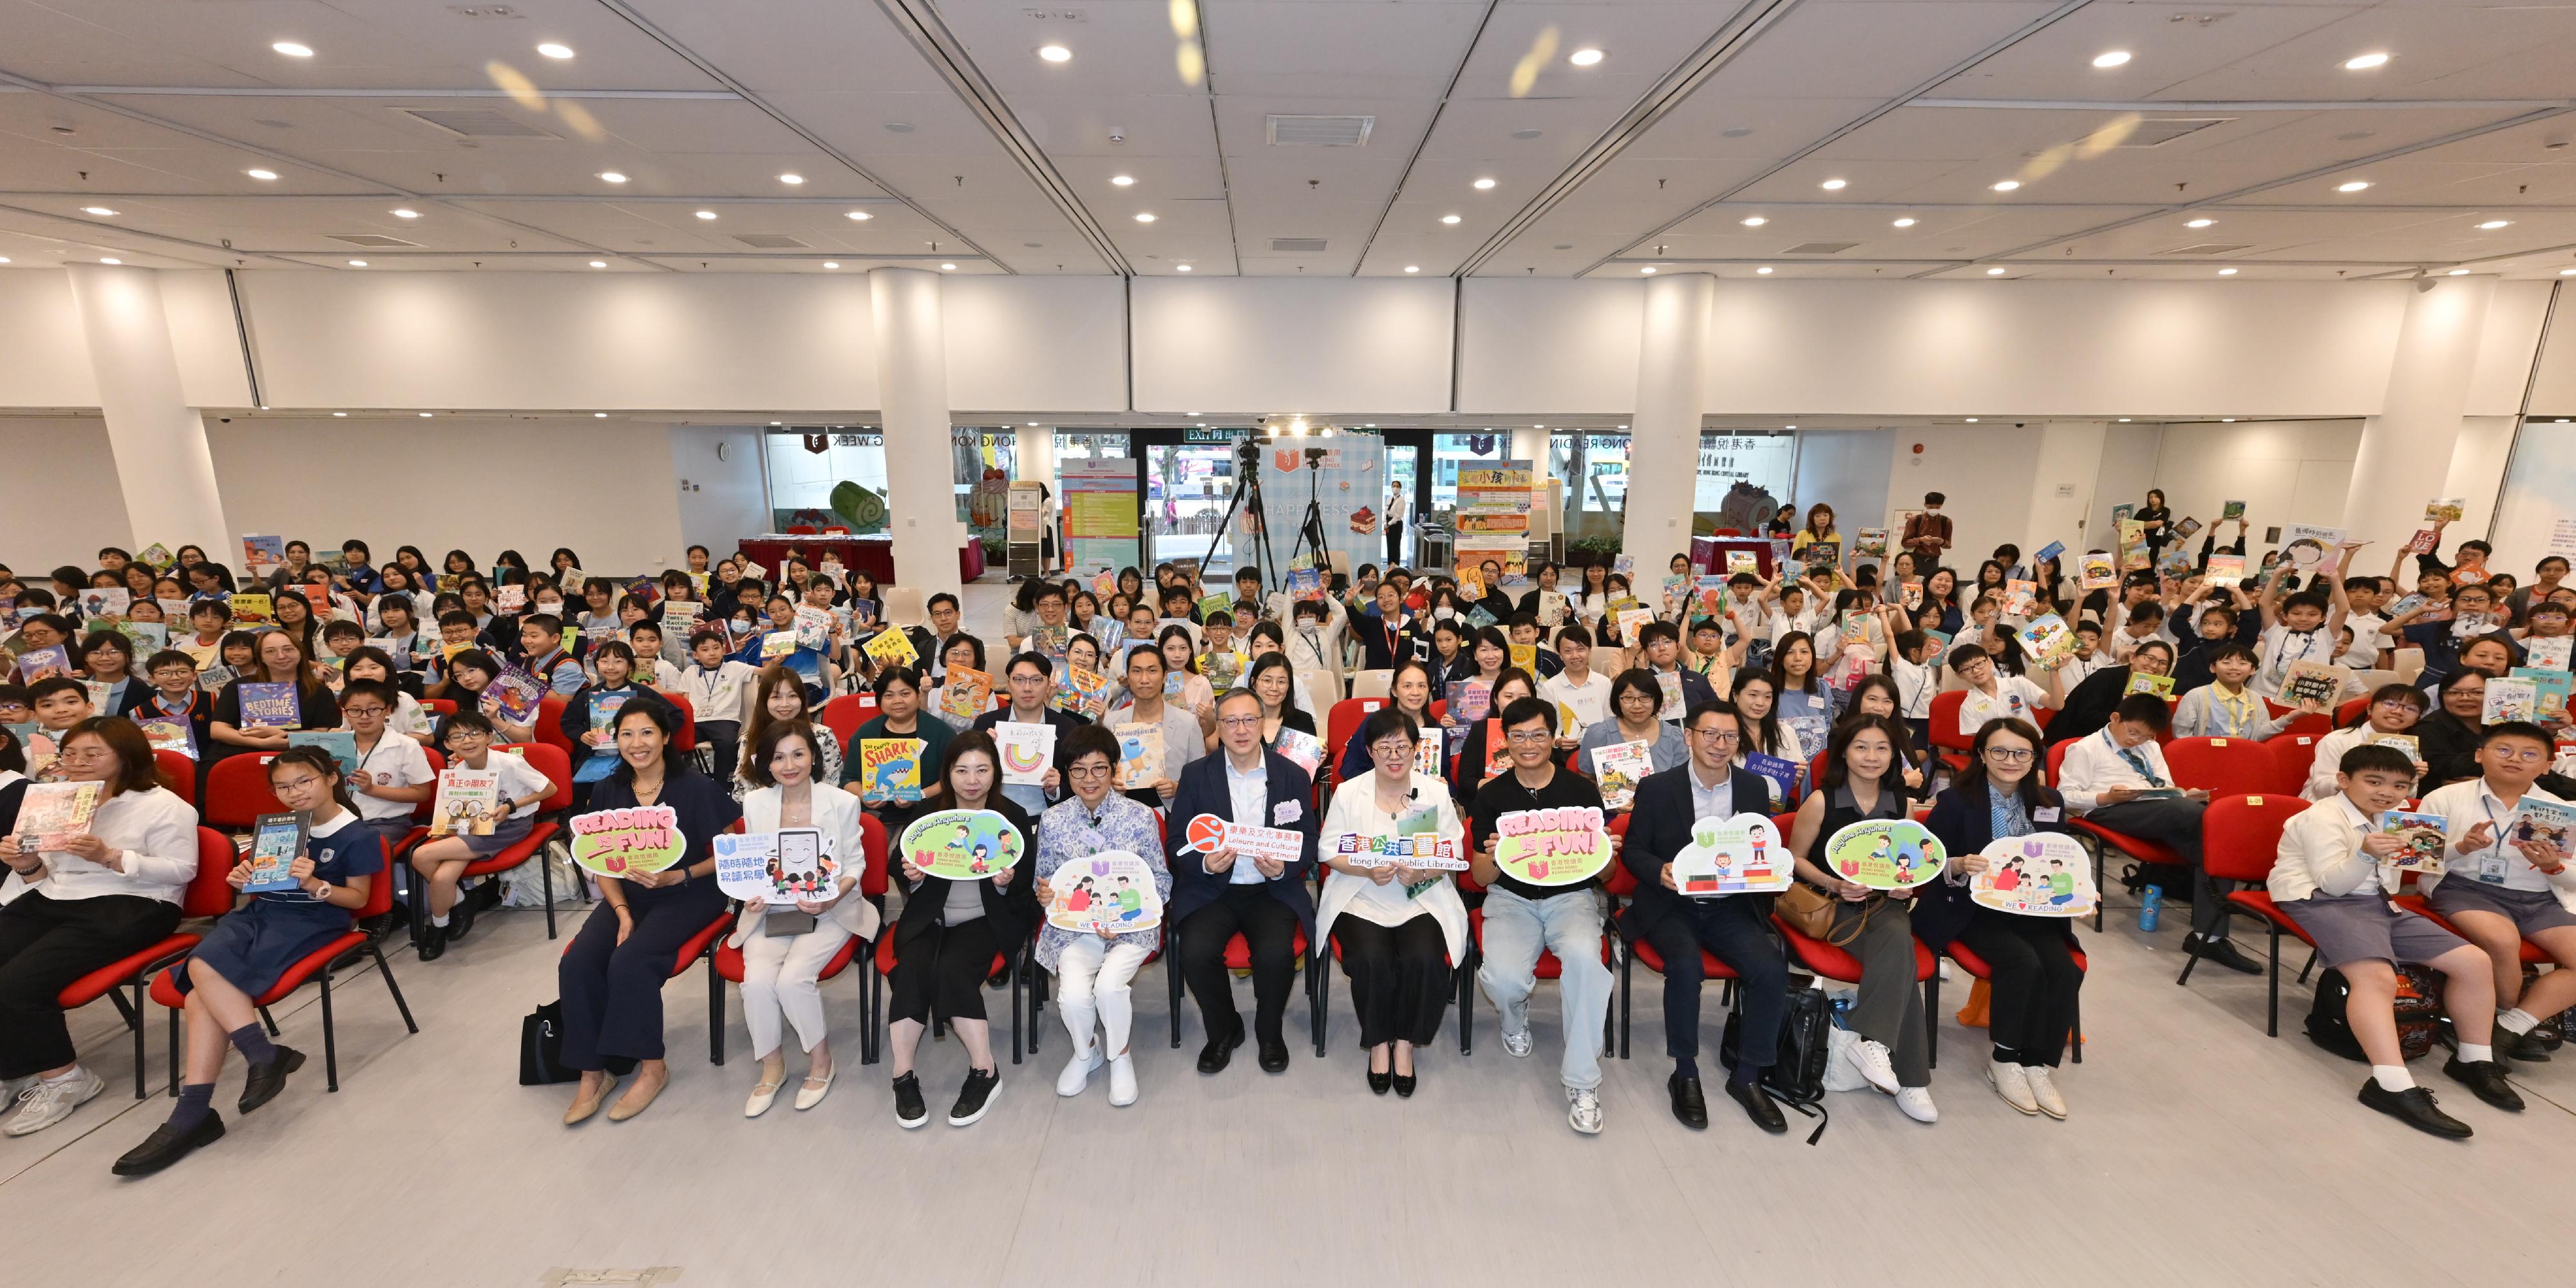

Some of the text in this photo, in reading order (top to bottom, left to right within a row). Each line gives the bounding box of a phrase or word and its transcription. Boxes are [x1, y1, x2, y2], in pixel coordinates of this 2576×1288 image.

[1189, 430, 1210, 440] EXIT
[203, 674, 227, 685] DOG
[245, 699, 291, 712] BEDTIME
[252, 706, 294, 717] STORIES
[864, 741, 909, 768] SHARK
[873, 742, 891, 752] SNAPPY
[573, 809, 674, 835] READING
[907, 813, 971, 844] Anytime Anywhere
[1499, 810, 1601, 837] READING
[594, 828, 674, 852] IS FUN!
[1229, 825, 1302, 843] 康樂及文化事務署
[1831, 824, 1892, 854] Anytime Anywhere
[1228, 837, 1255, 846] Leisure
[1271, 842, 1300, 851] Cultural
[1340, 834, 1452, 858] 香港公共圖書館
[1519, 831, 1601, 857] IS FUN!
[718, 857, 765, 870] 隨時隨地
[1350, 857, 1372, 867] Hong
[1374, 858, 1393, 866] Kon
[1427, 860, 1468, 869] Libraries
[721, 869, 765, 882] 易讀易學
